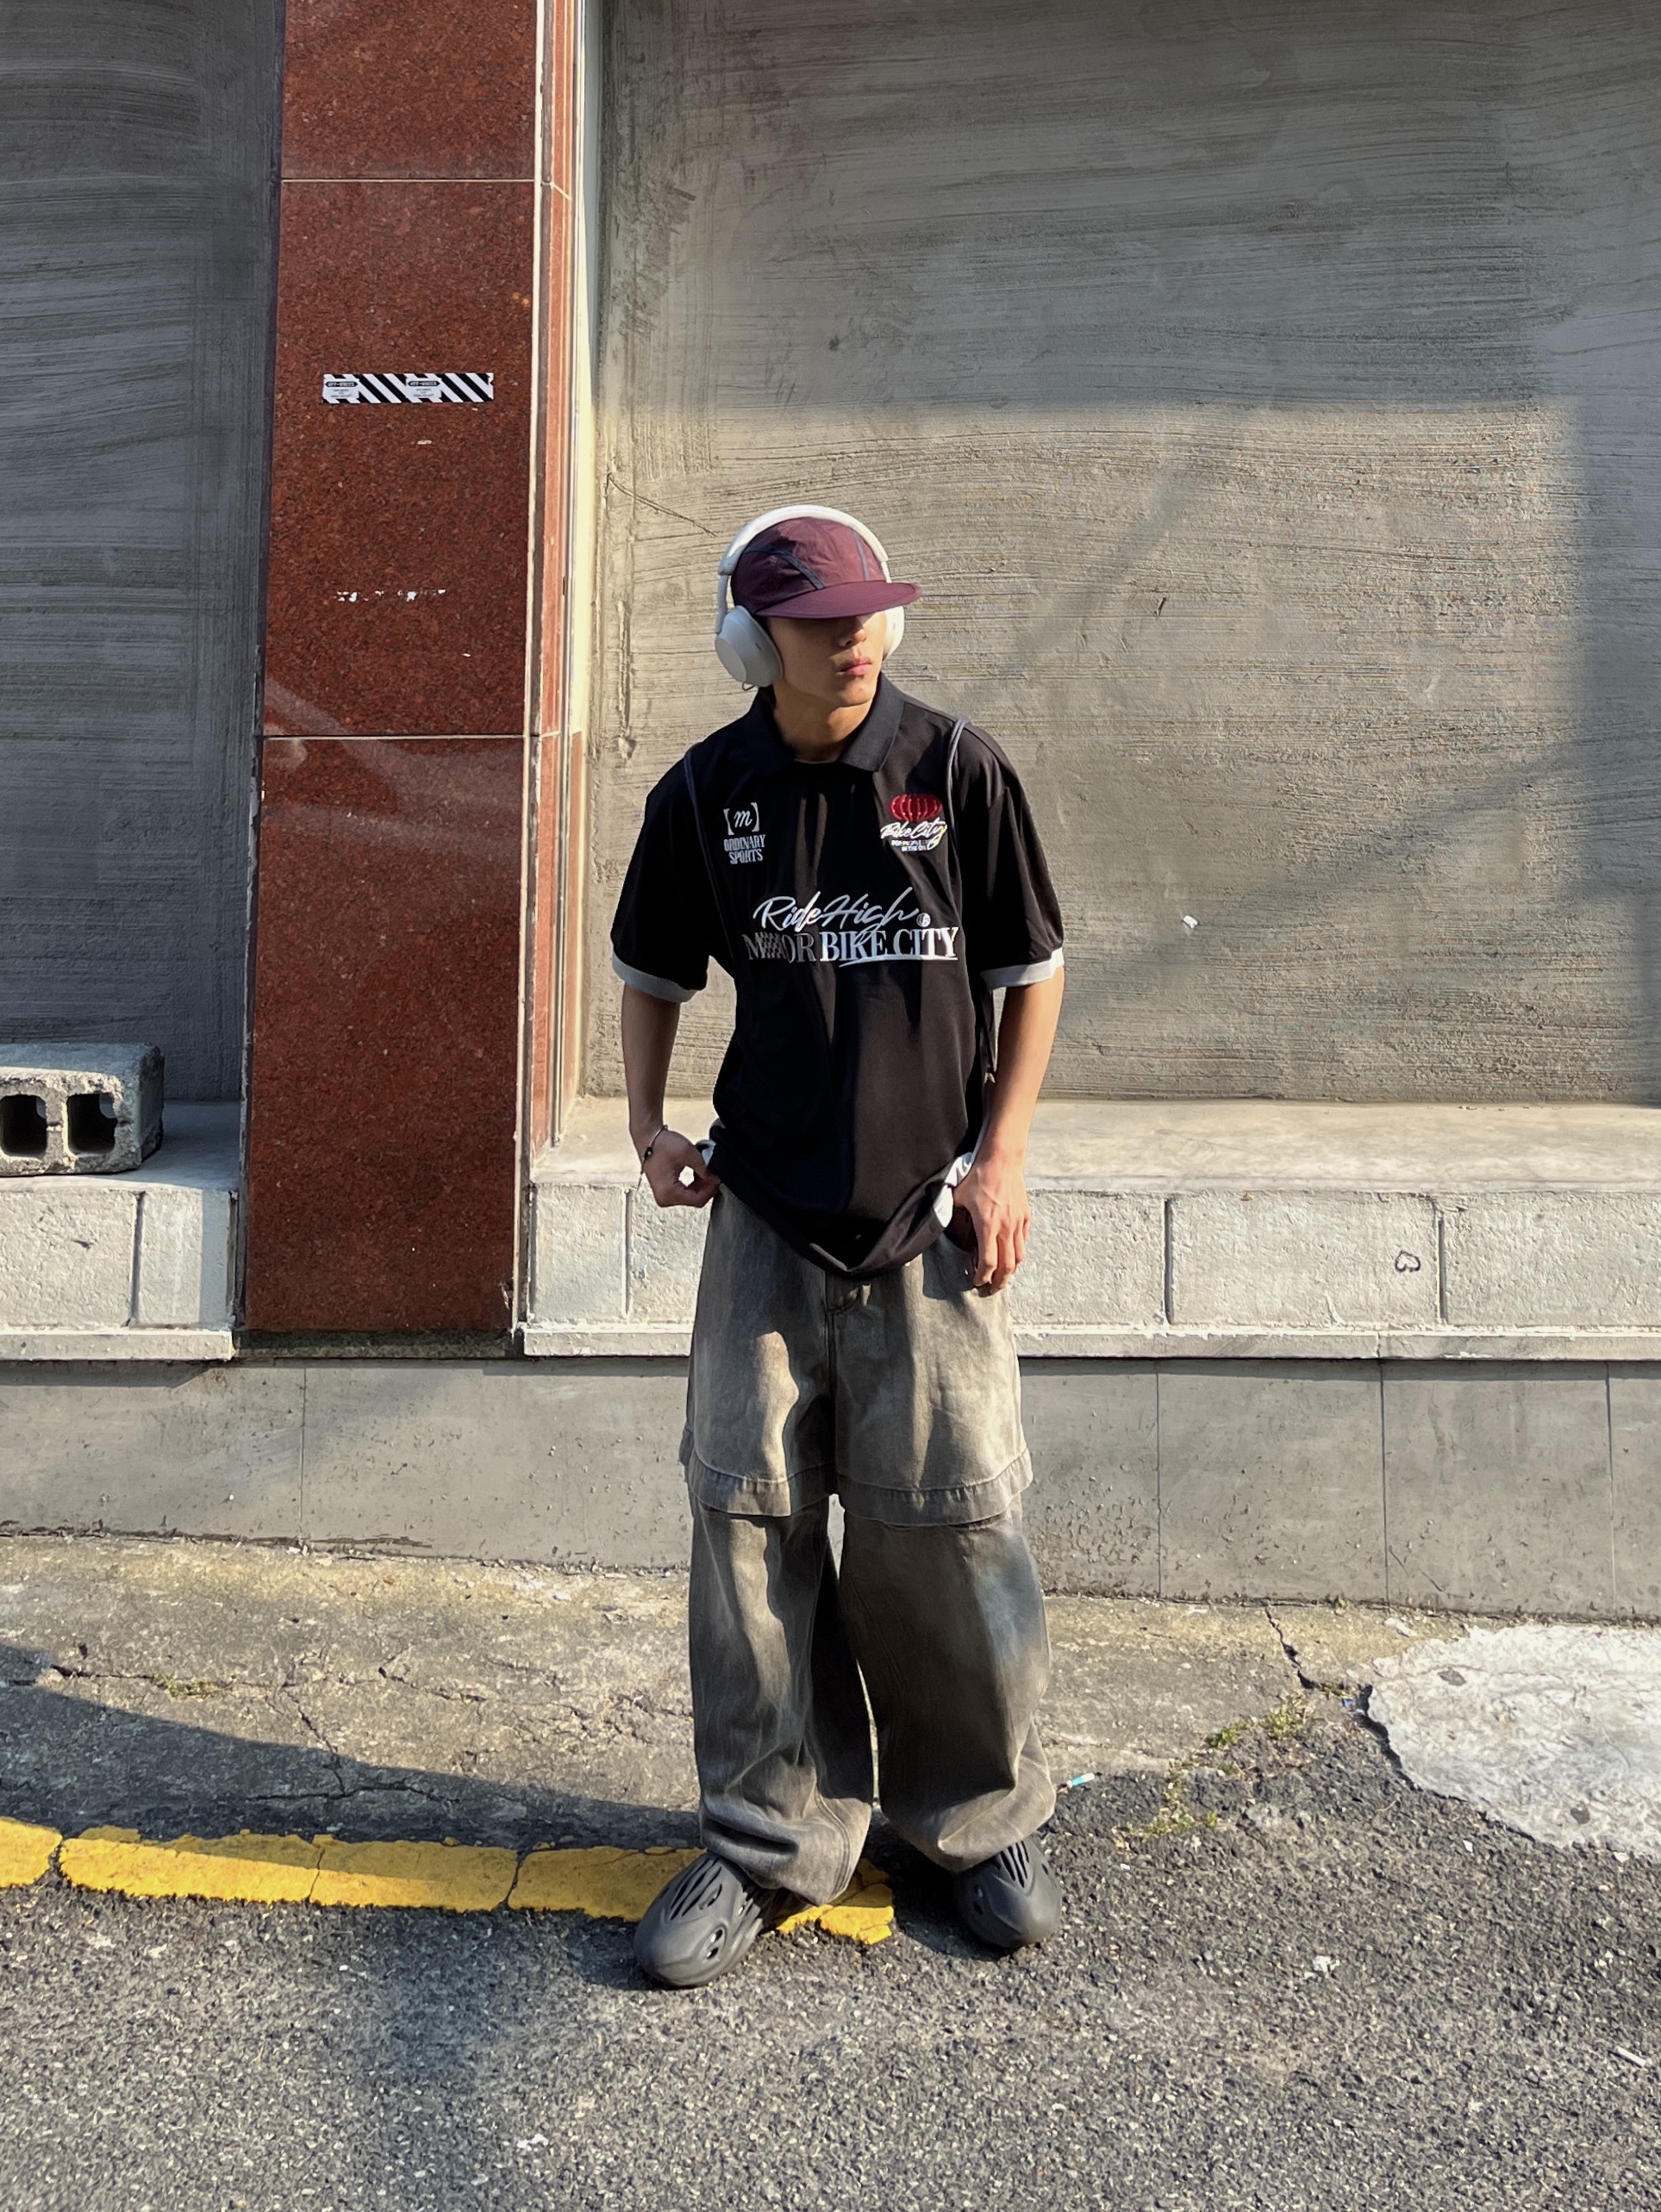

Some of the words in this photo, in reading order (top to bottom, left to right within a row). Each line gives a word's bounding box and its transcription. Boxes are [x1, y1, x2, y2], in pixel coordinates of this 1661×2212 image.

[723, 834, 765, 851] ORDINARY
[728, 848, 764, 864] SPORTS
[752, 891, 821, 932] Ride
[819, 886, 920, 948] High
[741, 932, 817, 963] MOR
[820, 930, 887, 963] BIKE
[892, 926, 959, 958] CITY
